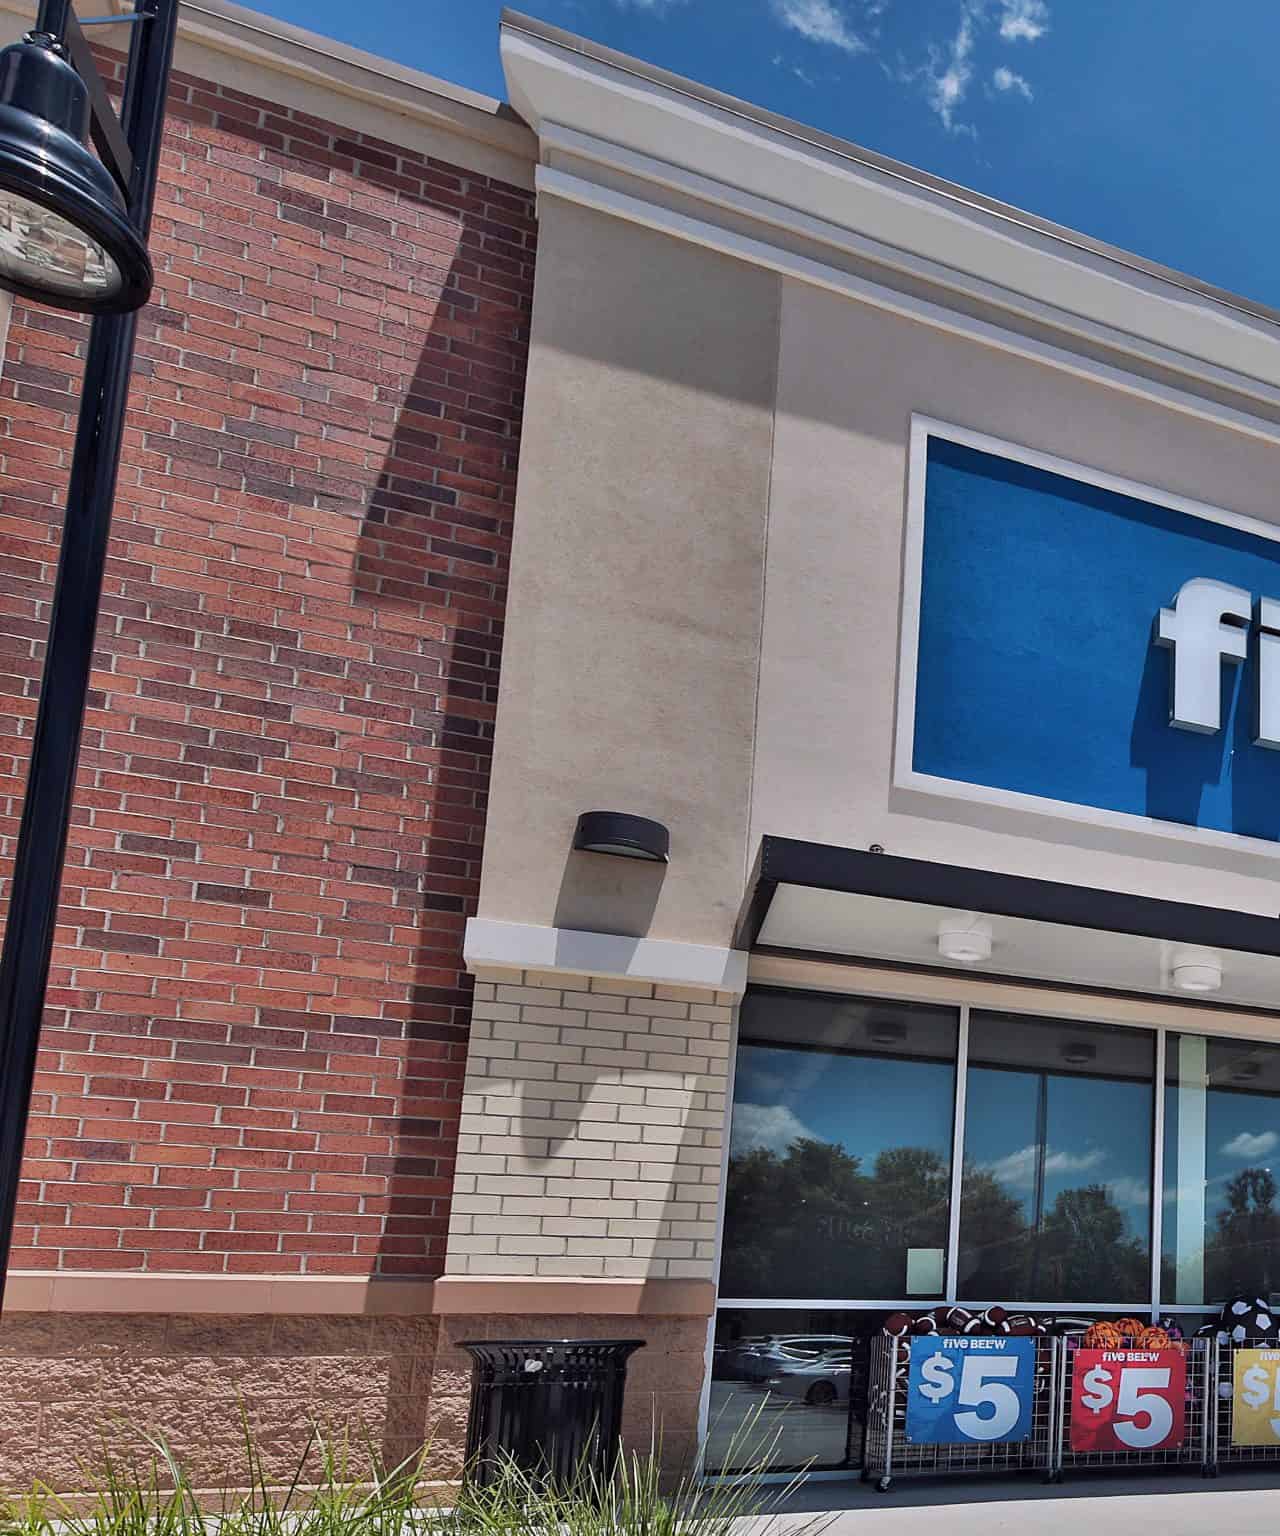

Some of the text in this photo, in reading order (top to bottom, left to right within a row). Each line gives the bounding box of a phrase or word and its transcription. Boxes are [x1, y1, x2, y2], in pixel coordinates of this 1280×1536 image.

[943, 1338, 968, 1349] five
[1102, 1351, 1126, 1362] five
[917, 1351, 1020, 1441] $5
[1080, 1363, 1174, 1449] $5
